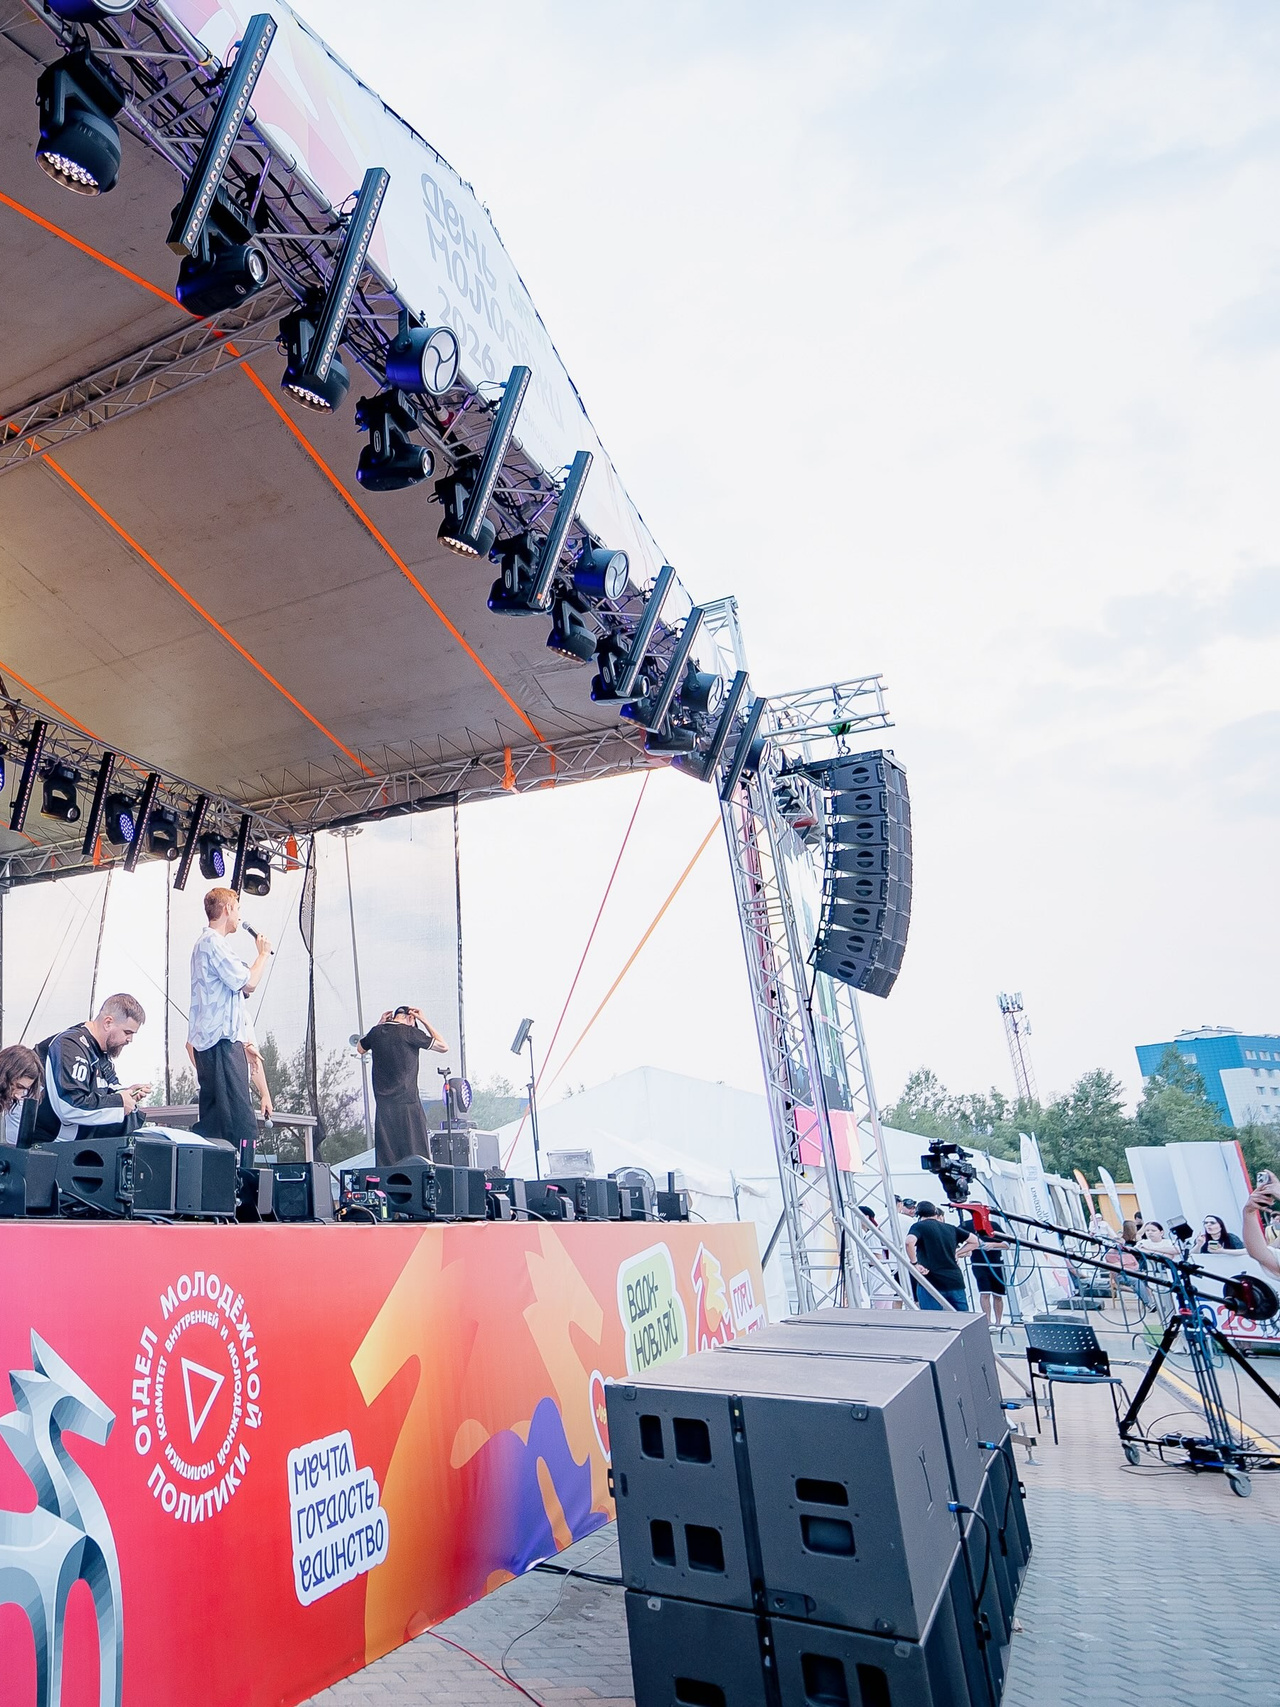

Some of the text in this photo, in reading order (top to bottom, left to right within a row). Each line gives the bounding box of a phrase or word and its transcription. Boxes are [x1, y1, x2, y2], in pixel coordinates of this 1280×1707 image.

[71, 1062, 88, 1082] 10
[164, 1309, 220, 1353] ВНУТРЕННЕЙ
[220, 1324, 229, 1341] И
[131, 1271, 262, 1523] ОТДЕЛ МОЛОДЁЖНОЙ ПОЛИТИКИ
[154, 1355, 168, 1441] КОМИТЕТ
[164, 1442, 215, 1480] ПОЛИТИКИ
[294, 1442, 351, 1495] МЕЧТА
[297, 1479, 374, 1544] ГОРДОСТЬ
[299, 1518, 384, 1592] ЕДИНСТВО
